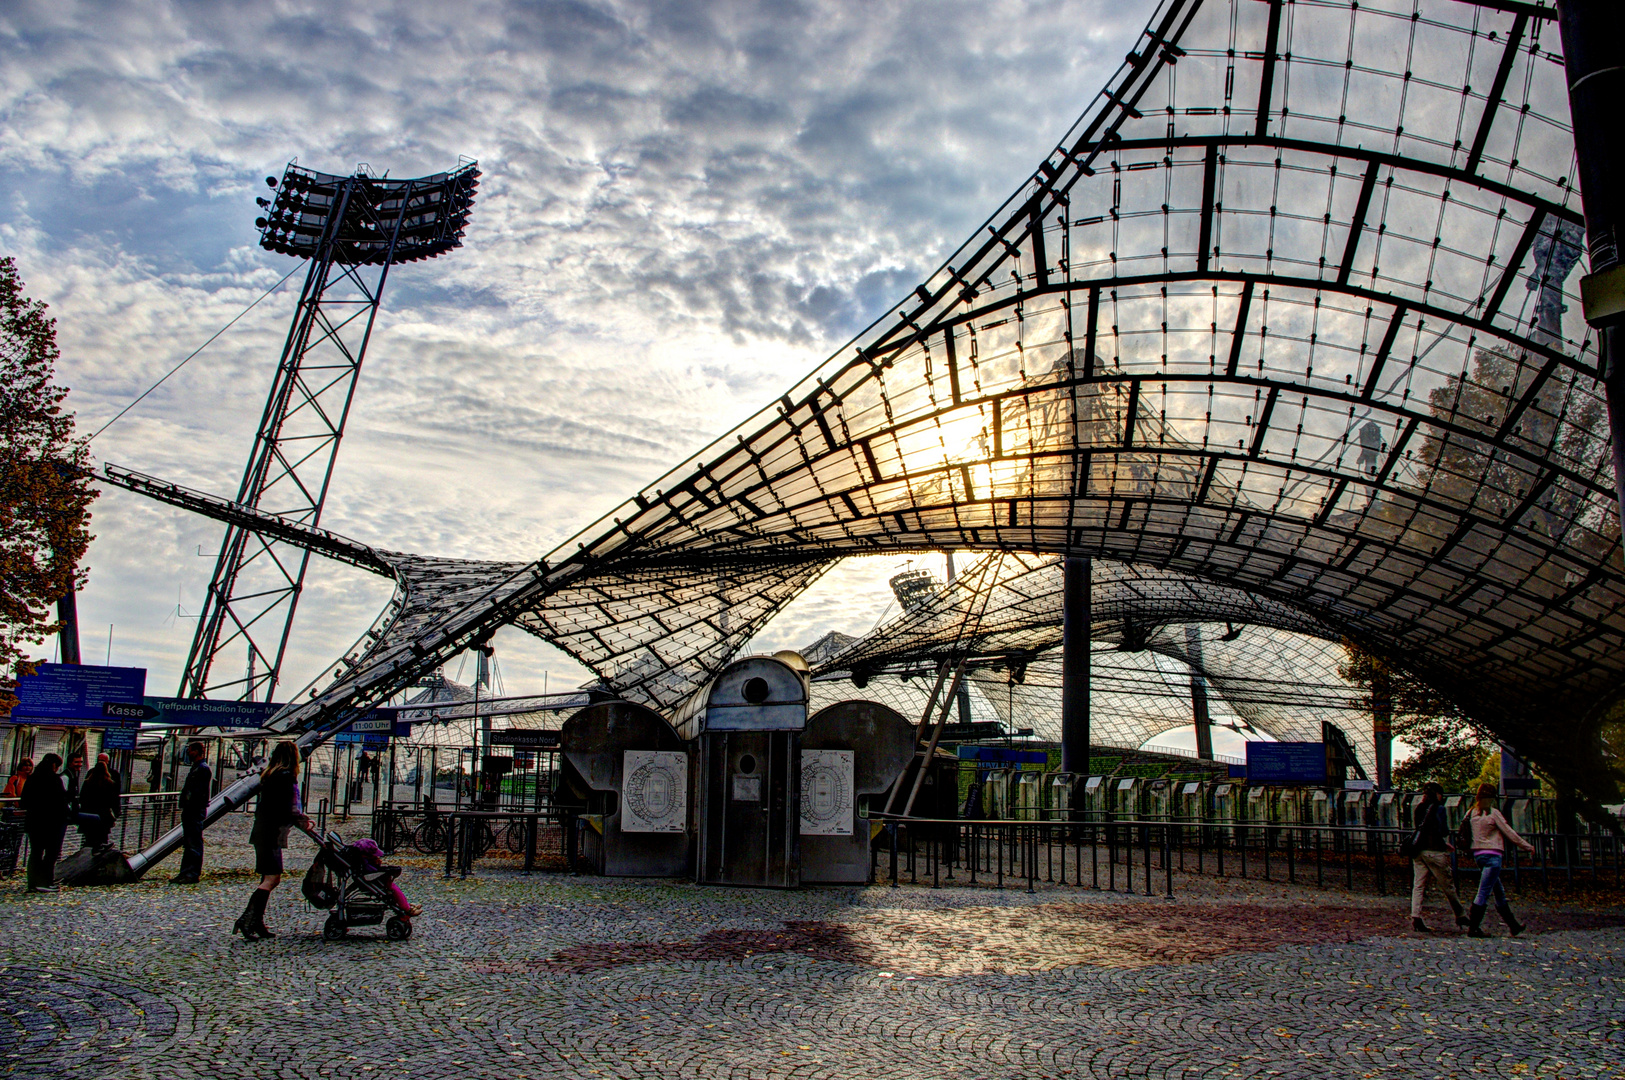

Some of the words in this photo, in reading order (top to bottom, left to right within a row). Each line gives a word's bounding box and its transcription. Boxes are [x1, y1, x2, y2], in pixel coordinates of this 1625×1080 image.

[107, 705, 144, 717] Kasse
[157, 701, 201, 712] Treffpunkt
[203, 703, 236, 713] Stadion
[237, 705, 256, 714] Tour
[230, 717, 253, 725] 16.4.
[354, 722, 374, 730] 11:00
[374, 720, 389, 729] Uhr
[492, 734, 538, 744] Stadionkasse
[538, 736, 556, 744] Nord
